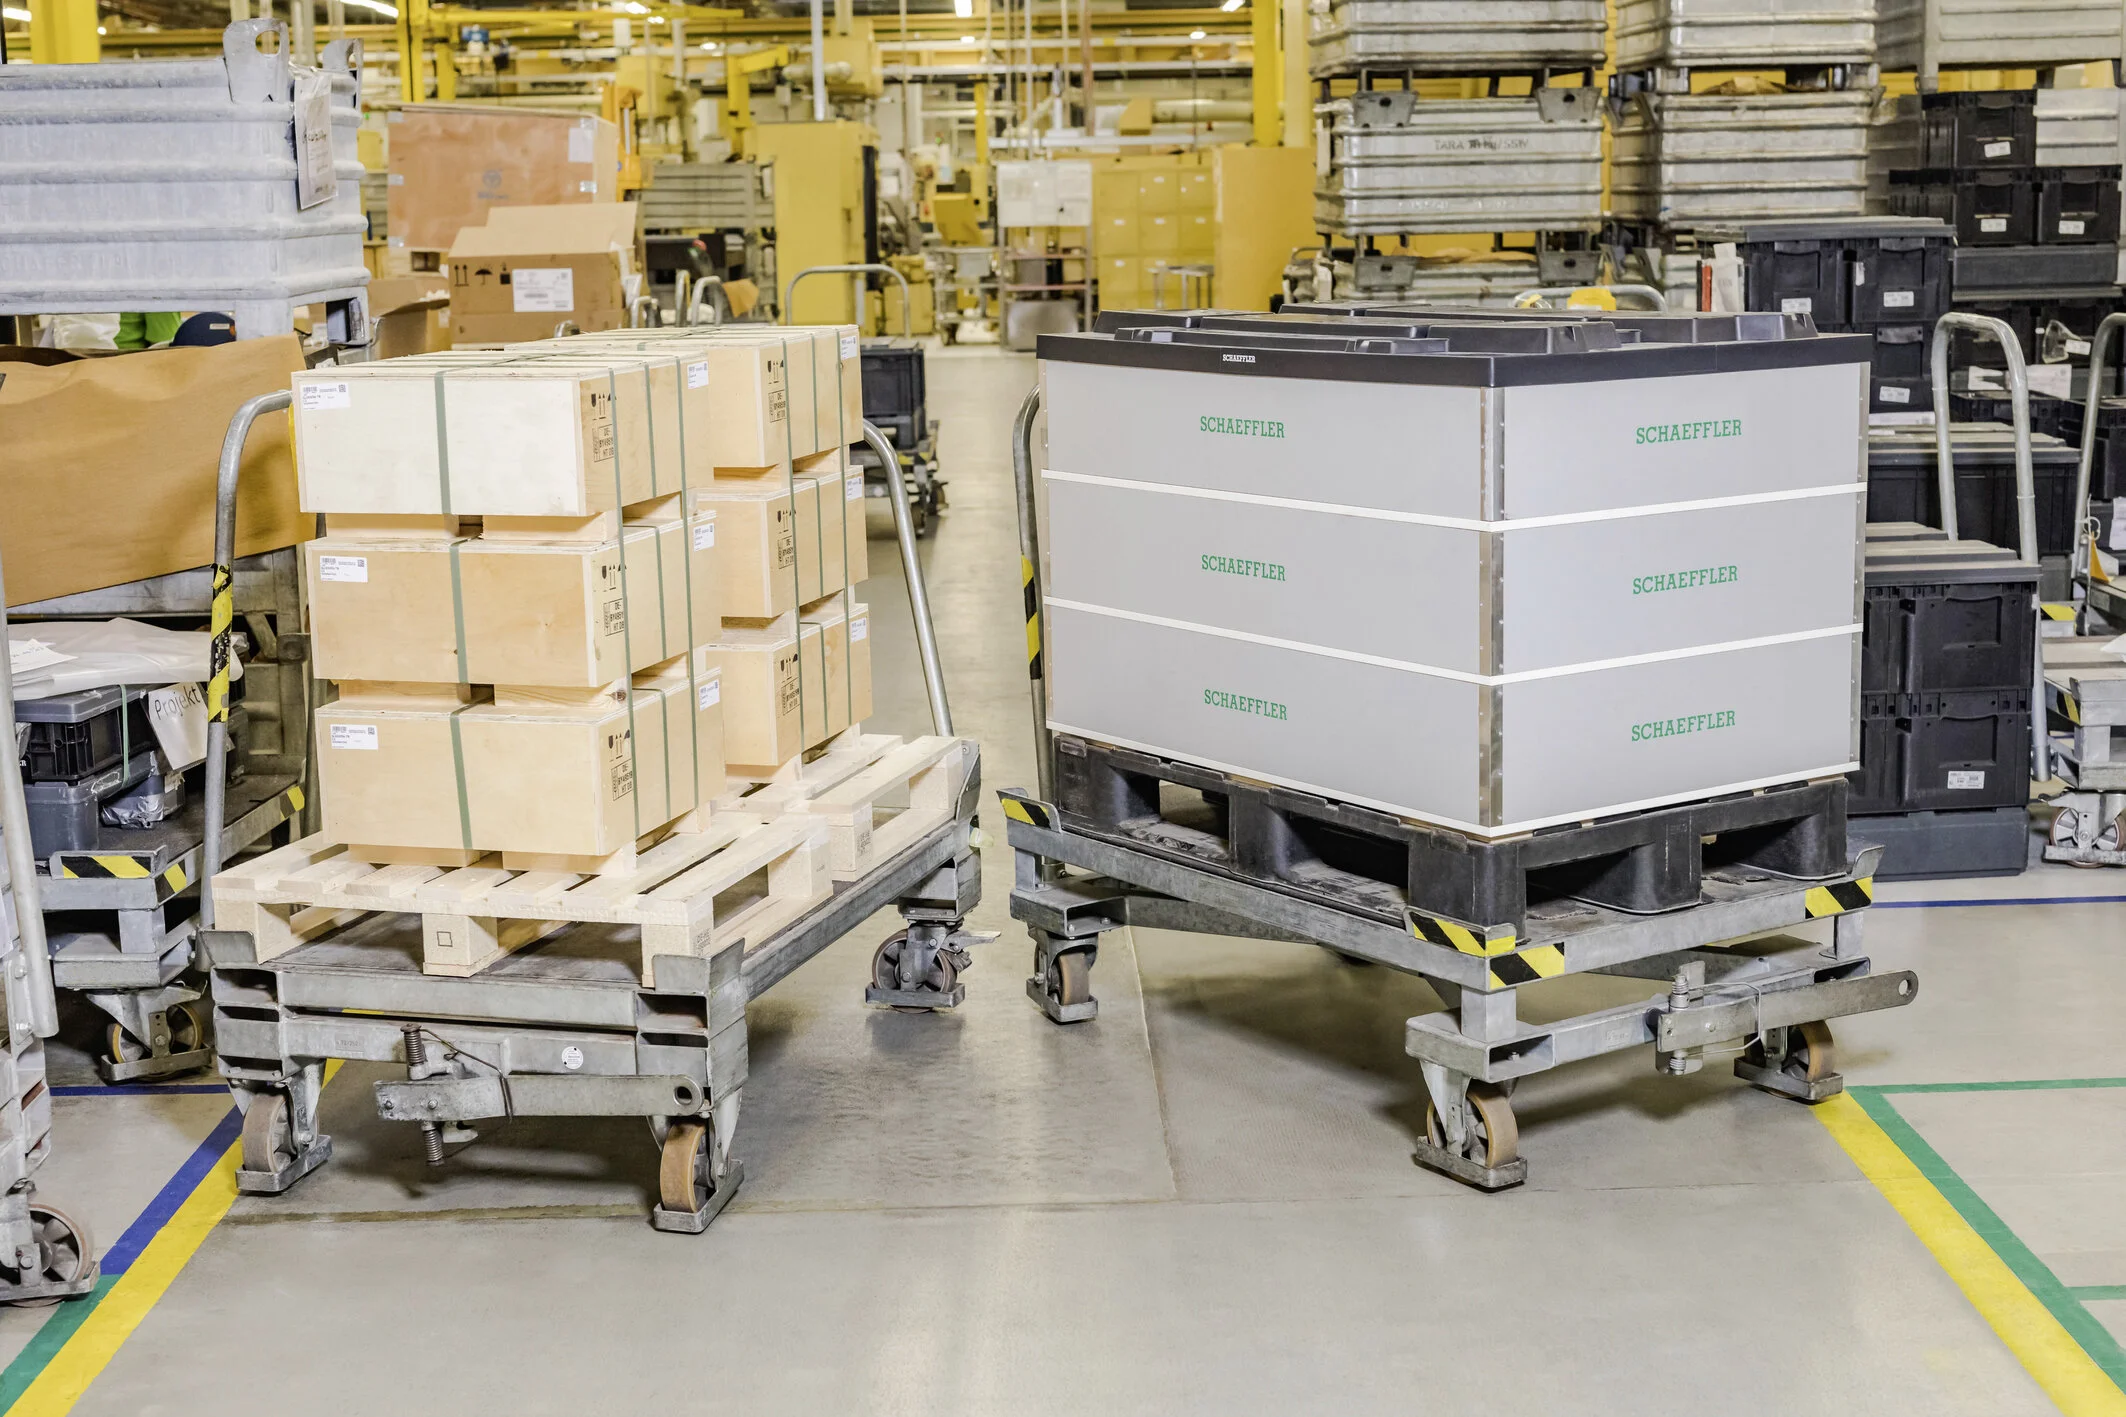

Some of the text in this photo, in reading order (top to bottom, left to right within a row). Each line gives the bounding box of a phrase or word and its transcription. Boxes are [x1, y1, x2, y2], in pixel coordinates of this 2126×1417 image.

[1434, 139, 1465, 151] TARA
[1222, 354, 1256, 363] SCHAEFFLER
[1199, 415, 1285, 439] SCHAEFFLER
[1635, 418, 1743, 445] SCHAEFFLER
[1200, 554, 1286, 581] SCHAEFFLER
[1631, 565, 1738, 595] SCHAEFFLER
[154, 685, 201, 720] Projekt
[1203, 688, 1288, 720] SCHAEFFLER
[1631, 709, 1736, 742] SCHAEFFLER
